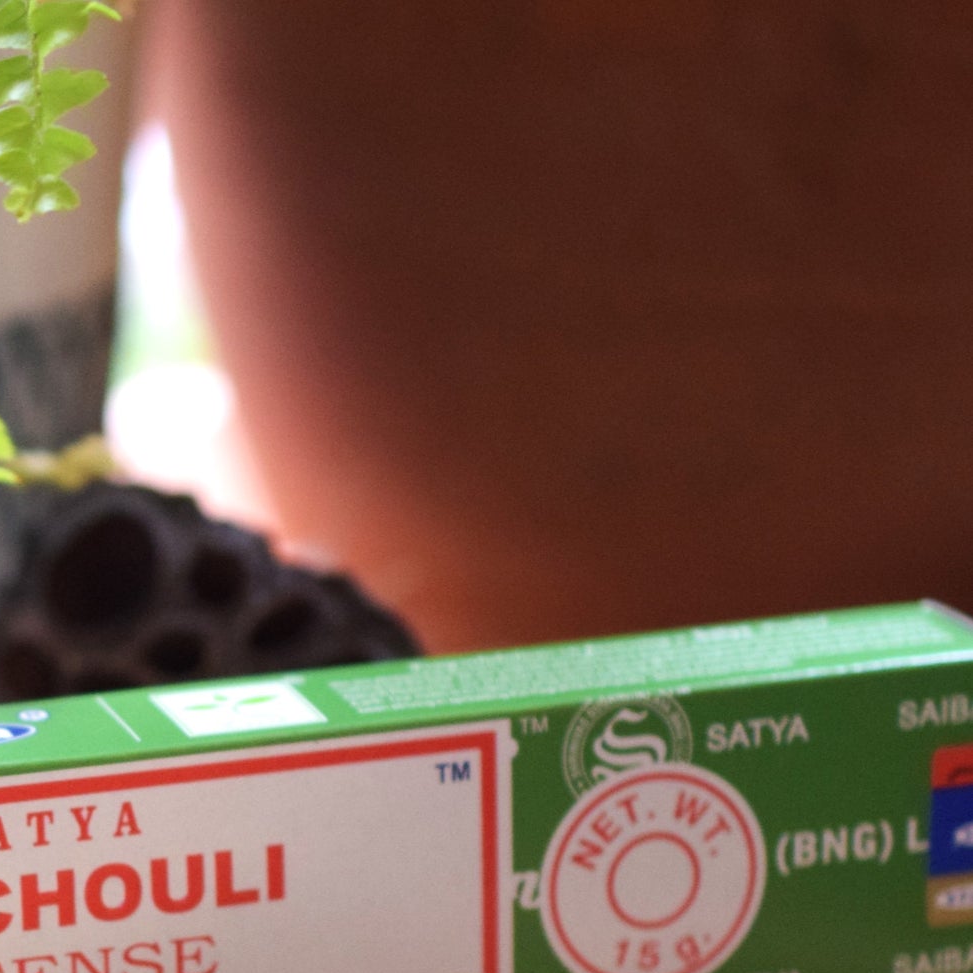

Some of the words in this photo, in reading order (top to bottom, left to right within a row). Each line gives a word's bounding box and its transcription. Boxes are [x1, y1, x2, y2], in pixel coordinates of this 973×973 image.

[898, 694, 973, 731] SAIB
[707, 714, 809, 752] SATYA
[777, 819, 891, 875] (BNG)
